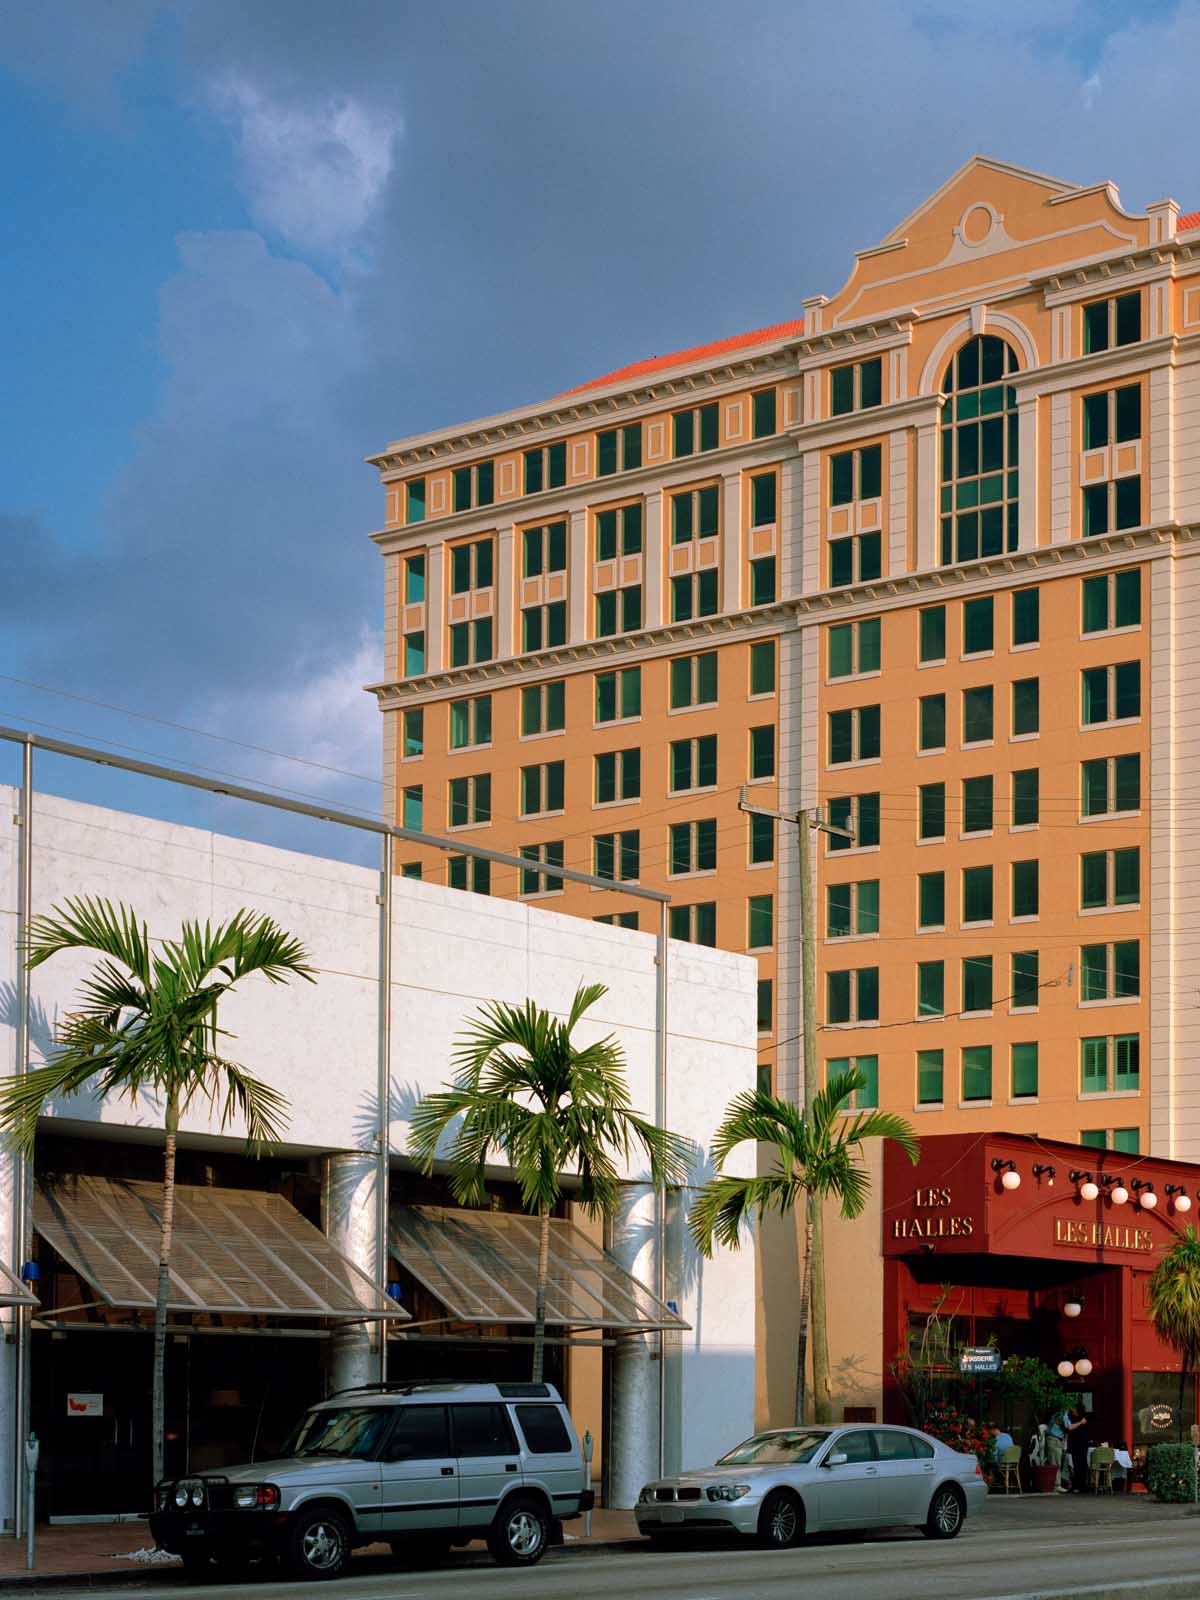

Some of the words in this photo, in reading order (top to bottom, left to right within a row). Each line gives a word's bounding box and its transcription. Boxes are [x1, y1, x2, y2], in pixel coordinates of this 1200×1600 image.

[916, 1187, 951, 1206] LES
[895, 1217, 973, 1237] HALLES
[1057, 1220, 1088, 1243] LES
[1092, 1222, 1153, 1250] HALLES
